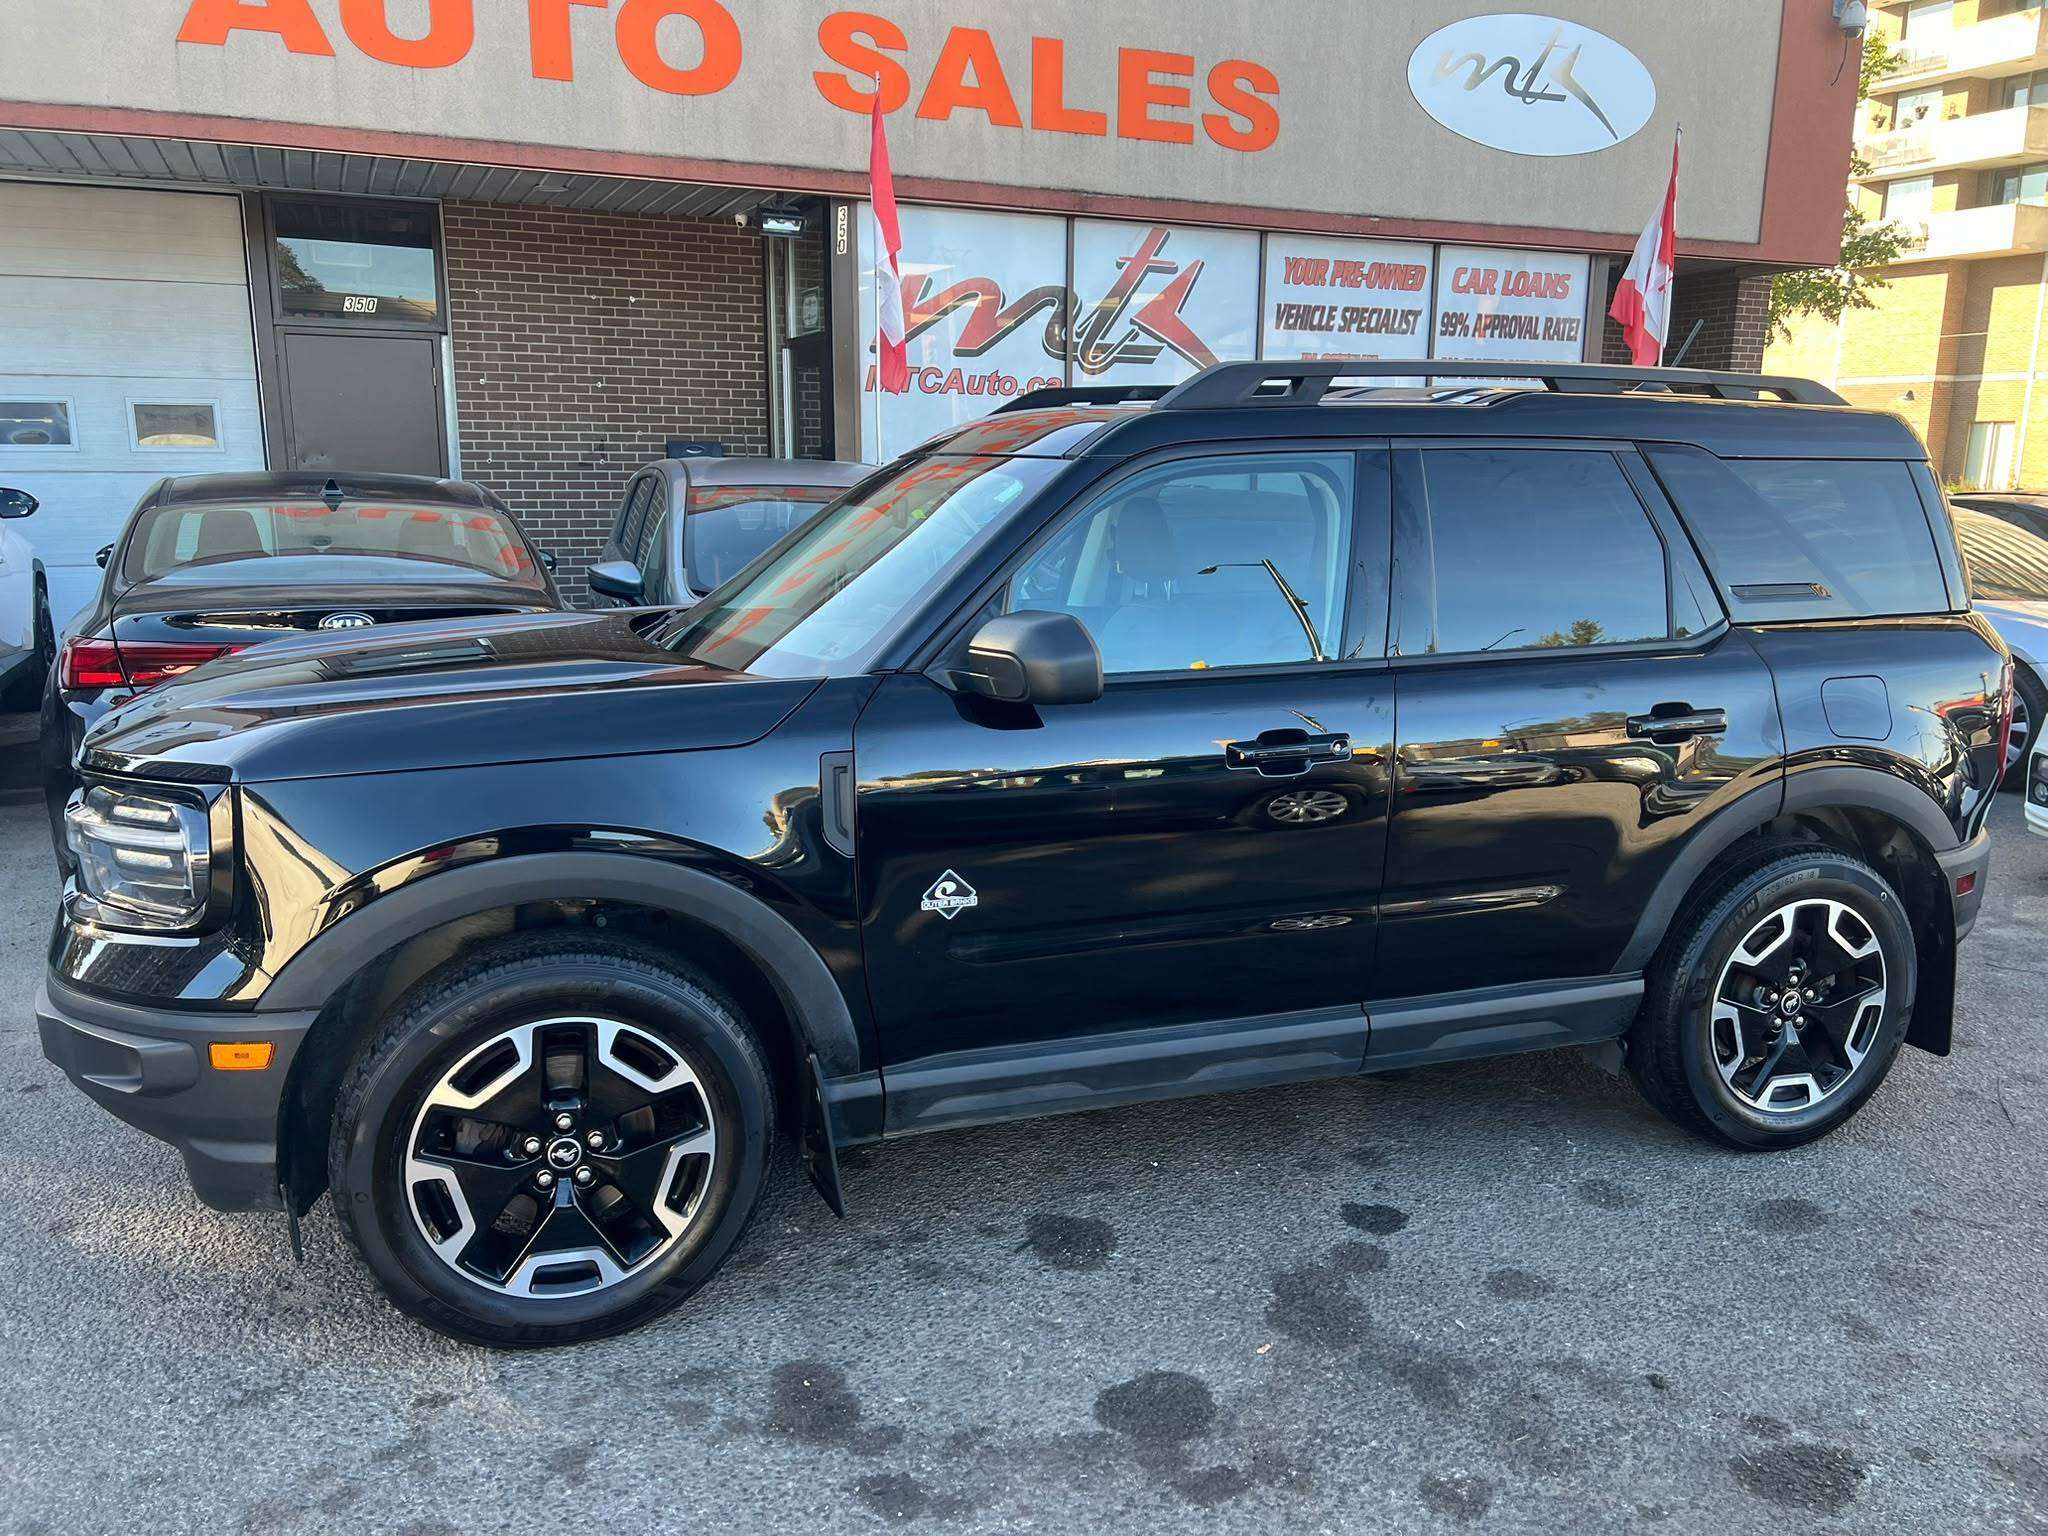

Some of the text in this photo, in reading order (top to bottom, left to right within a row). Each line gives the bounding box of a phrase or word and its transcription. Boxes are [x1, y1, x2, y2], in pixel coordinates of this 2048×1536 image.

[812, 11, 1280, 152] SALES
[838, 207, 847, 253] 350
[1283, 256, 1427, 292] YOUR PRE-OWNED
[1451, 267, 1572, 300] CAR LOANS
[344, 296, 378, 313] 350
[1274, 303, 1424, 336] VEHICLE SPECIALIST
[1440, 311, 1581, 342] 99% APPROVAL RATE!
